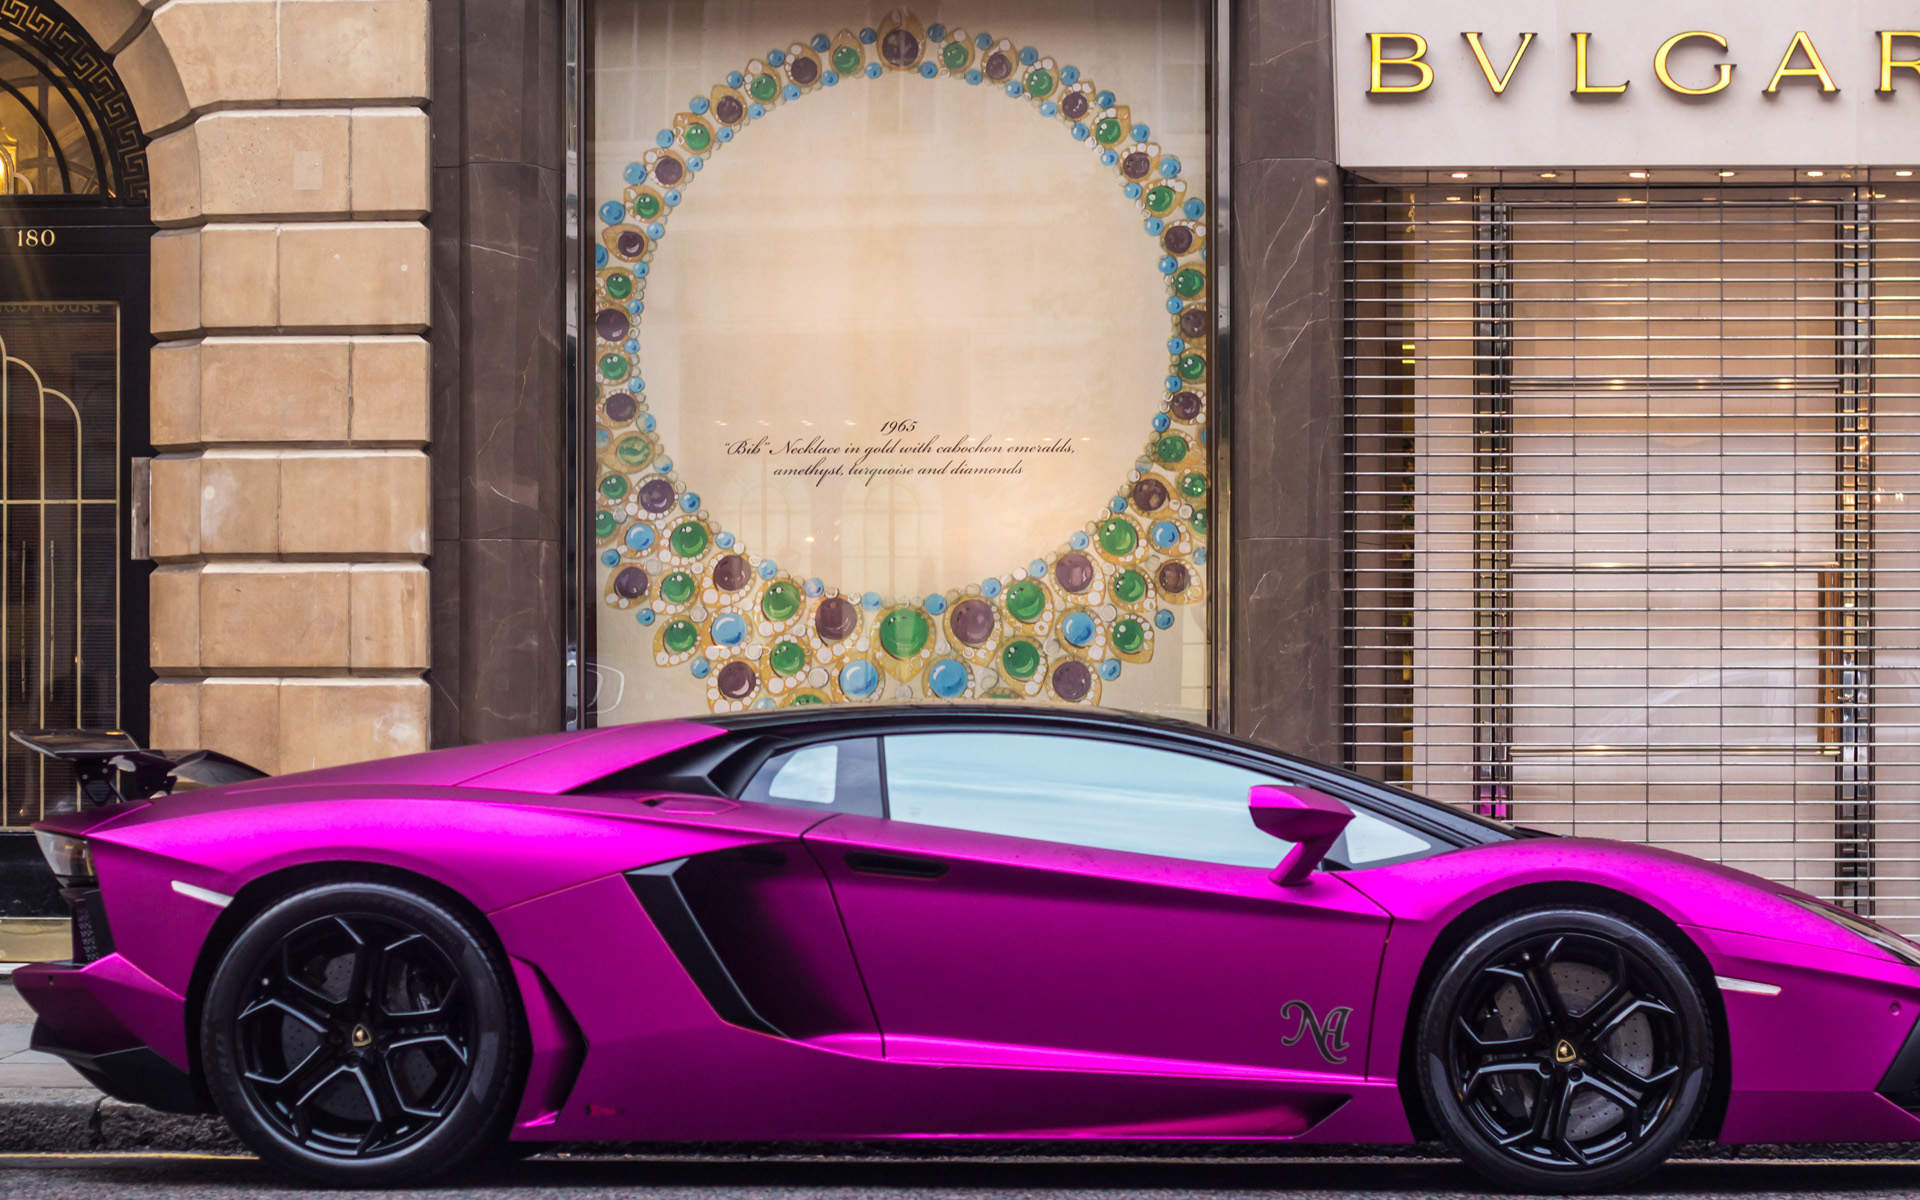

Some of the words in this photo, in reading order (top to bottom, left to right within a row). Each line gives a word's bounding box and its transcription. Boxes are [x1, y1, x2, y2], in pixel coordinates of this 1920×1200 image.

[17, 229, 56, 247] 180
[41, 303, 101, 313] HOUSE
[880, 419, 917, 436] 1965
[769, 435, 840, 455] Necklace
[844, 442, 860, 454] in
[855, 438, 902, 465] gold
[899, 434, 940, 454] with
[936, 434, 1002, 454] cabochon
[1006, 438, 1075, 454] emeralds,
[773, 456, 844, 487] amethyst,
[848, 462, 914, 487] turquoise
[917, 459, 954, 475] and
[950, 459, 1023, 475] diamonds
[1280, 999, 1354, 1064] NA
